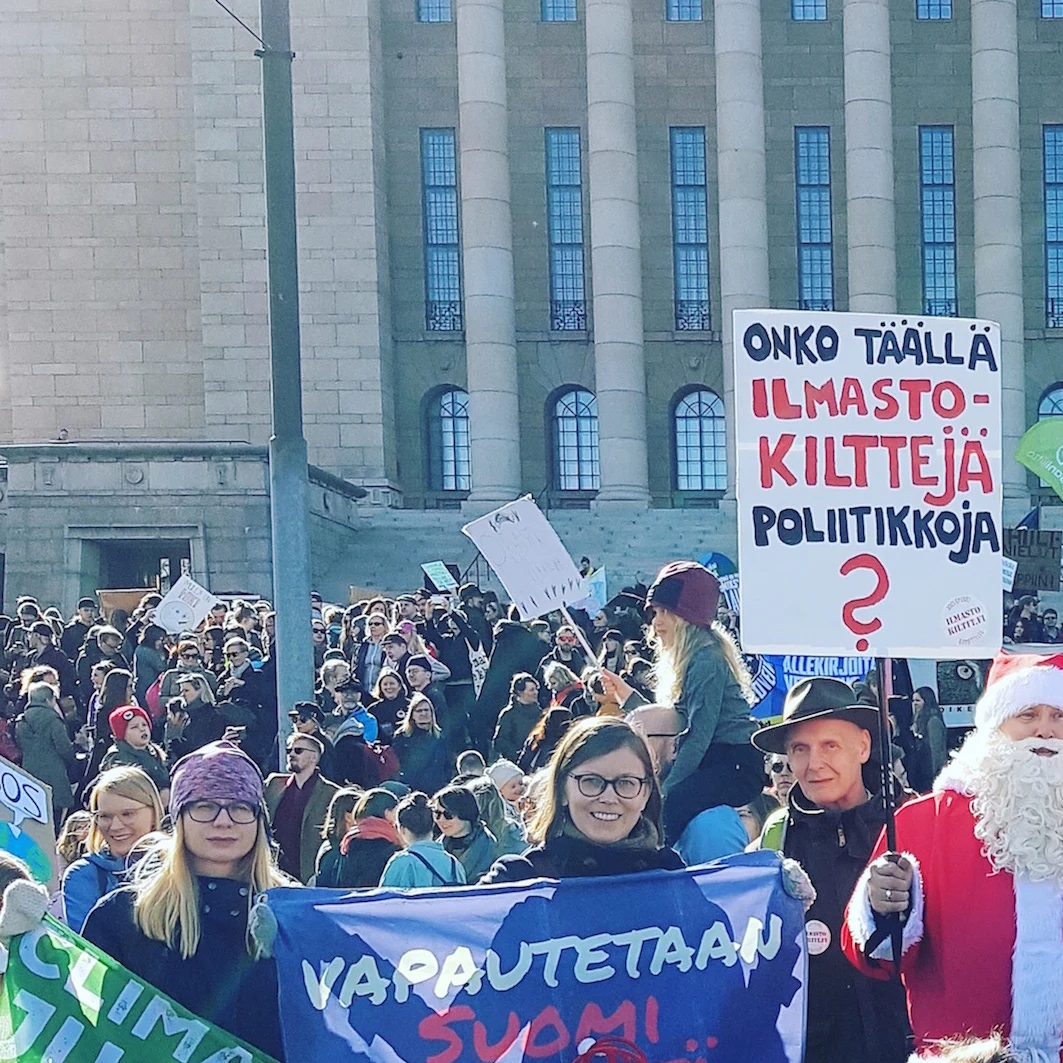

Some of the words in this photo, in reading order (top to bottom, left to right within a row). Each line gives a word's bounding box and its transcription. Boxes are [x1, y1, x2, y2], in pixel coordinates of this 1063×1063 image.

[743, 323, 839, 365] ONKO
[855, 320, 998, 372] TÄÄLLÄ
[752, 377, 990, 420] ILMASTO-
[759, 426, 993, 507] KILTTEJÄ
[752, 501, 1000, 565] POLIITIKKOJA
[839, 553, 890, 652] ?
[1, 771, 42, 819] OS
[302, 913, 782, 1010] VAPAUTETAAN
